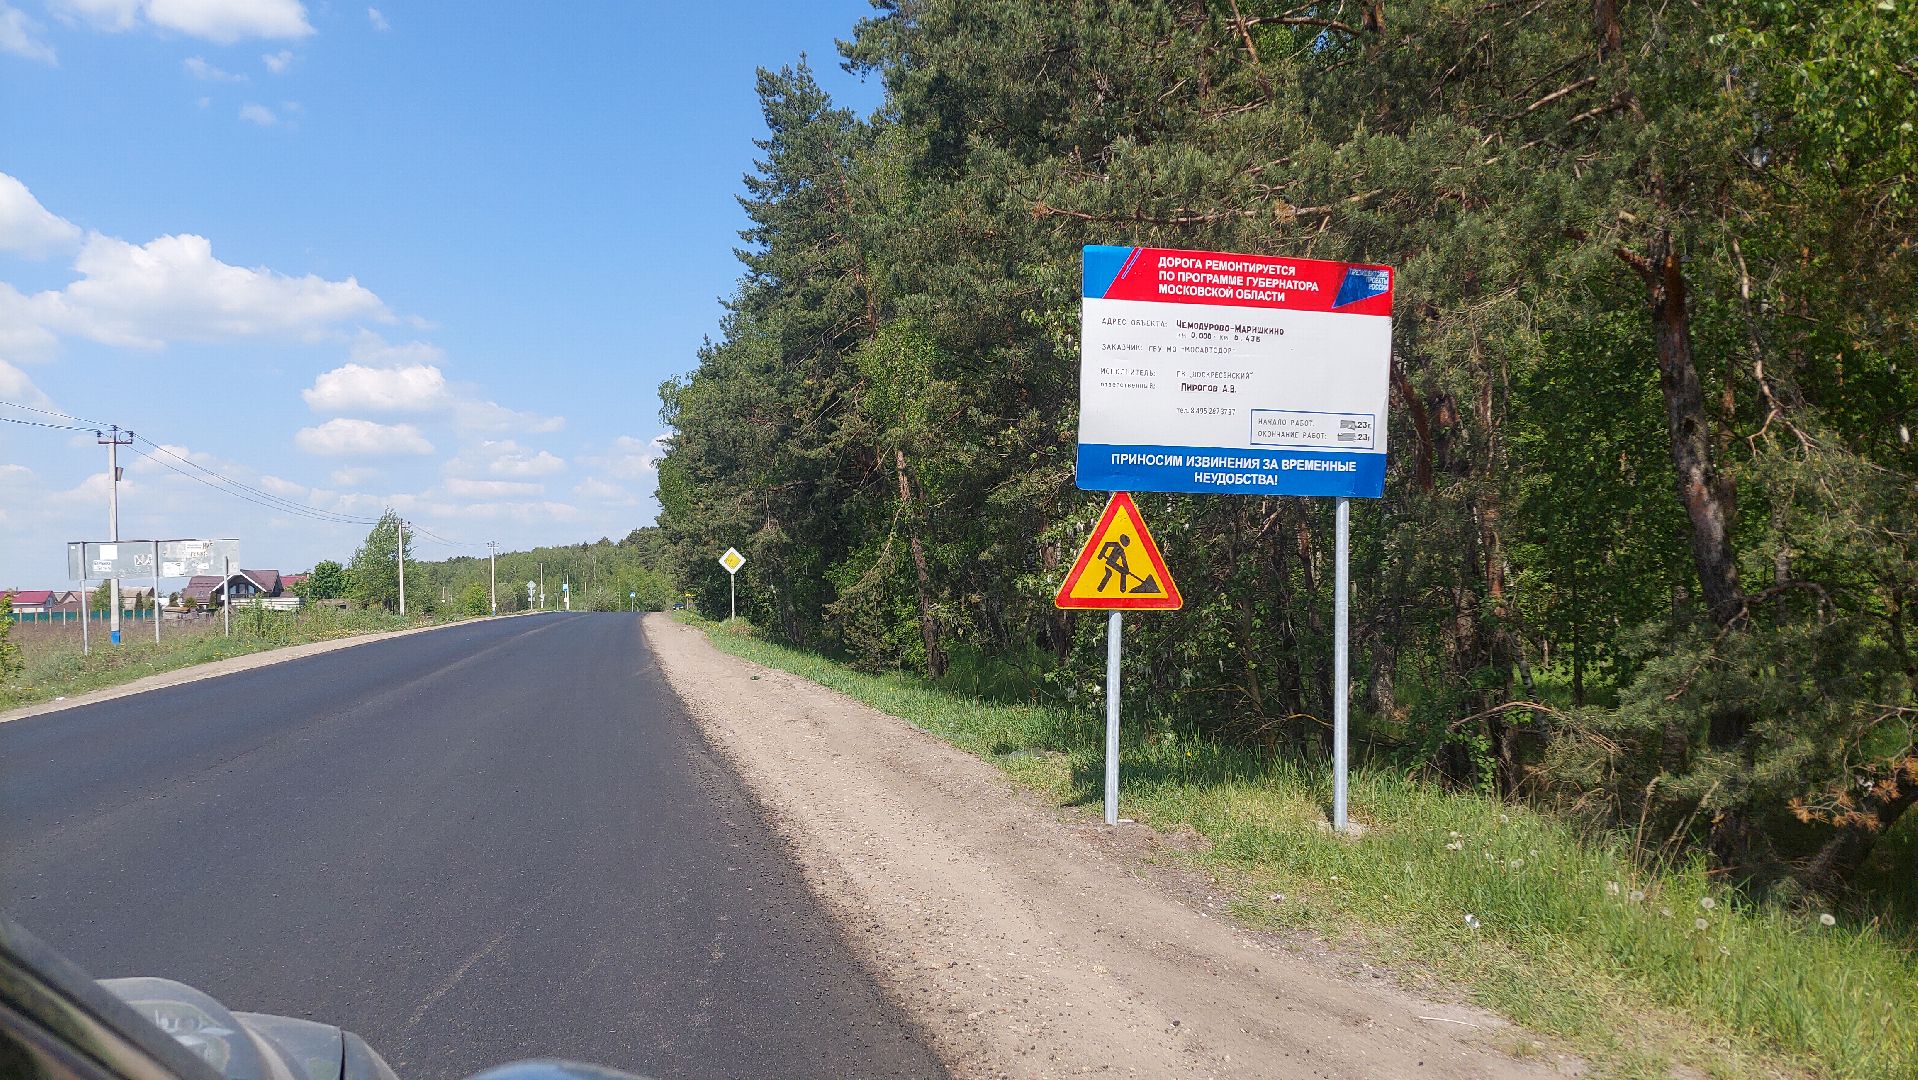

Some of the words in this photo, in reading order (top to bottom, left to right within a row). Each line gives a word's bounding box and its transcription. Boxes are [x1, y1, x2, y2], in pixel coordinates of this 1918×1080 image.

[1158, 256, 1204, 270] ДОРОГА
[1205, 260, 1296, 276] РЕМОНТИРУЕТСЯ
[1158, 270, 1175, 281] ПО
[1177, 271, 1244, 286] ПРОГРАММЕ
[1246, 276, 1320, 292] ГУБЕРНАТОРА
[1158, 284, 1234, 299] МОСКОВСКОЙ
[1236, 290, 1286, 302] ОБЛАСТИ
[1101, 317, 1127, 326] АДРЕС
[1258, 418, 1287, 426] НАЧАЛО
[1257, 430, 1299, 439] ОКОНЧАНИЕ
[1111, 453, 1183, 467] ПРИНОСИМ
[1185, 456, 1260, 470] ИЗВИНЕНИЯ
[1262, 459, 1280, 470] ЗА
[1282, 459, 1357, 472] ВРЕМЕННЫЕ
[1194, 471, 1278, 486] НЕУДОБСТВА!
